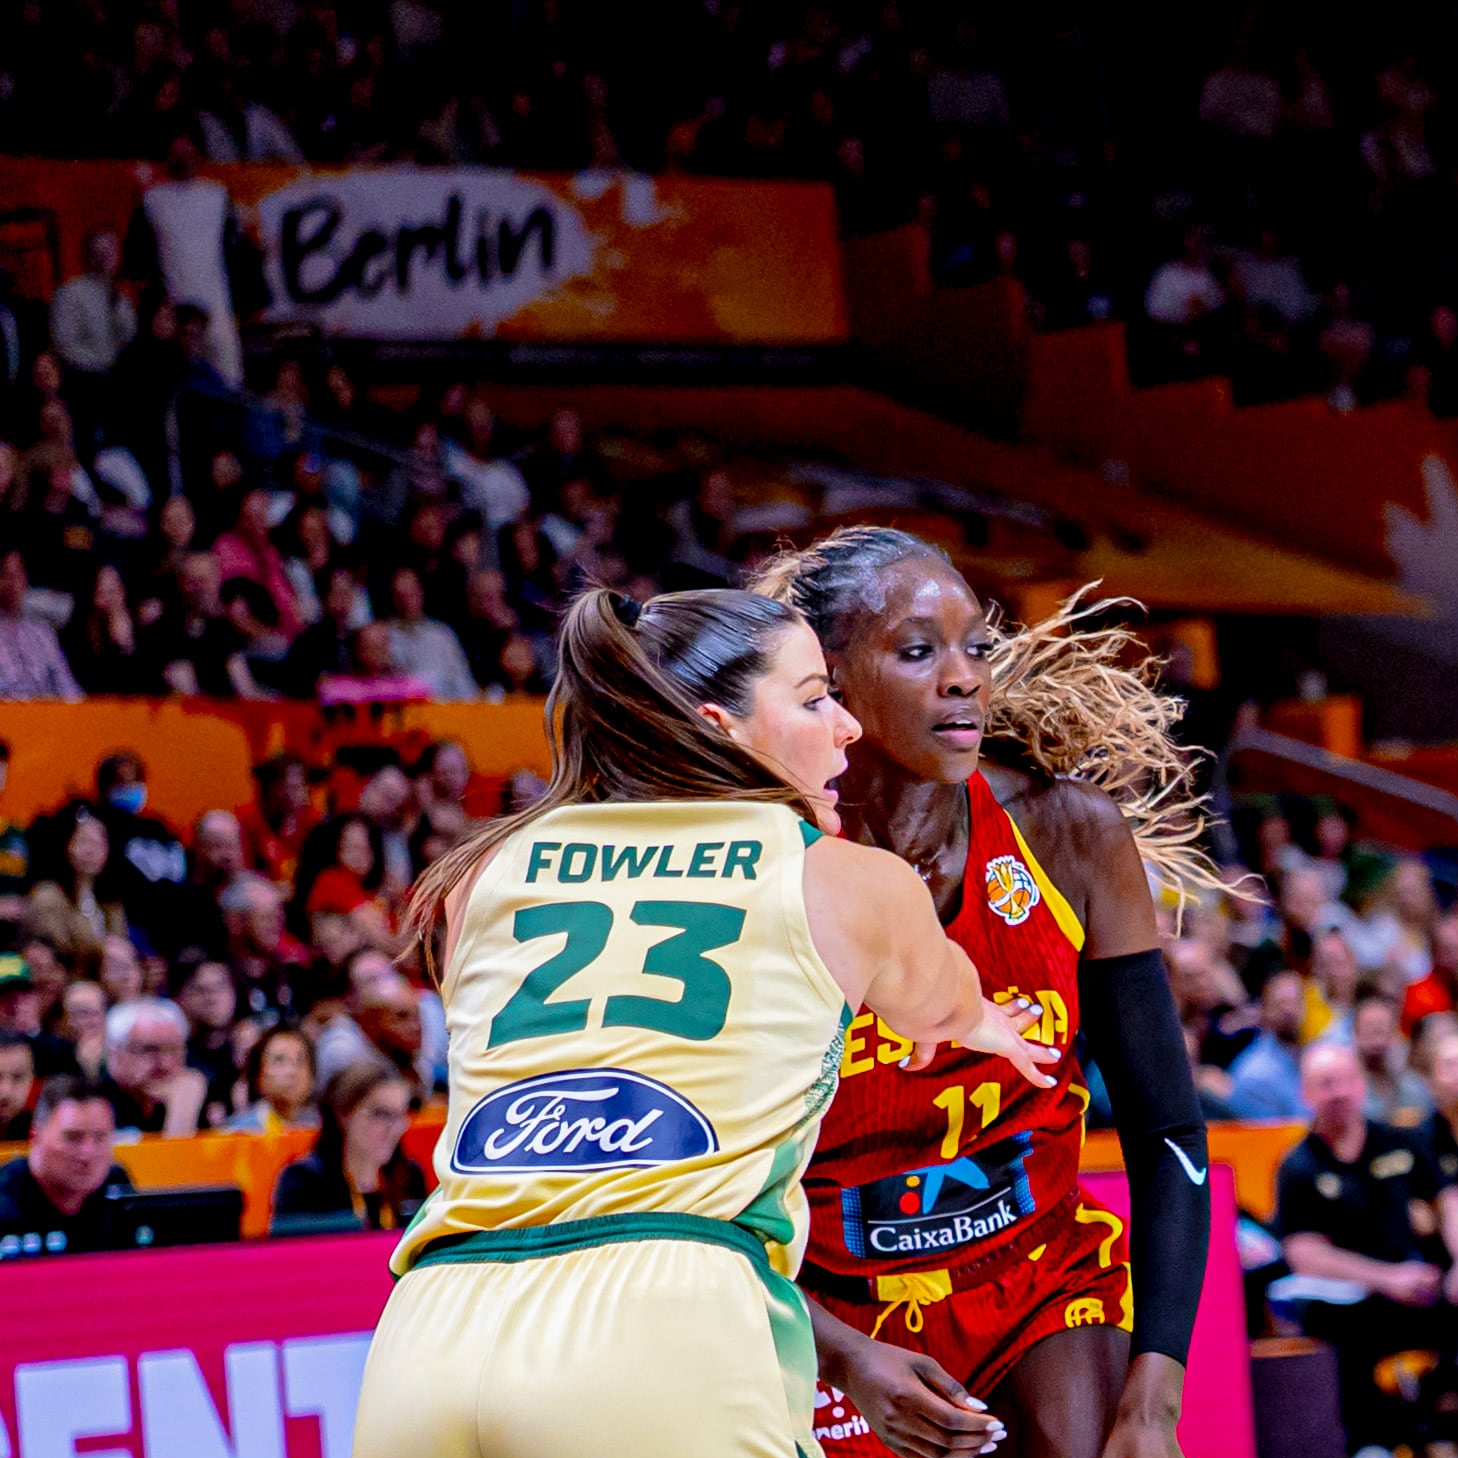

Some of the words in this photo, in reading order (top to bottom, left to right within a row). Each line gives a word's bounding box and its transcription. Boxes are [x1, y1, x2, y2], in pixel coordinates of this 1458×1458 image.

[280, 194, 557, 305] Berlin
[525, 840, 763, 885] FOWLER
[486, 899, 748, 1051] 23
[483, 1085, 663, 1157] Ford
[932, 1082, 1001, 1160] 11
[869, 1200, 1018, 1253] CaixaBank
